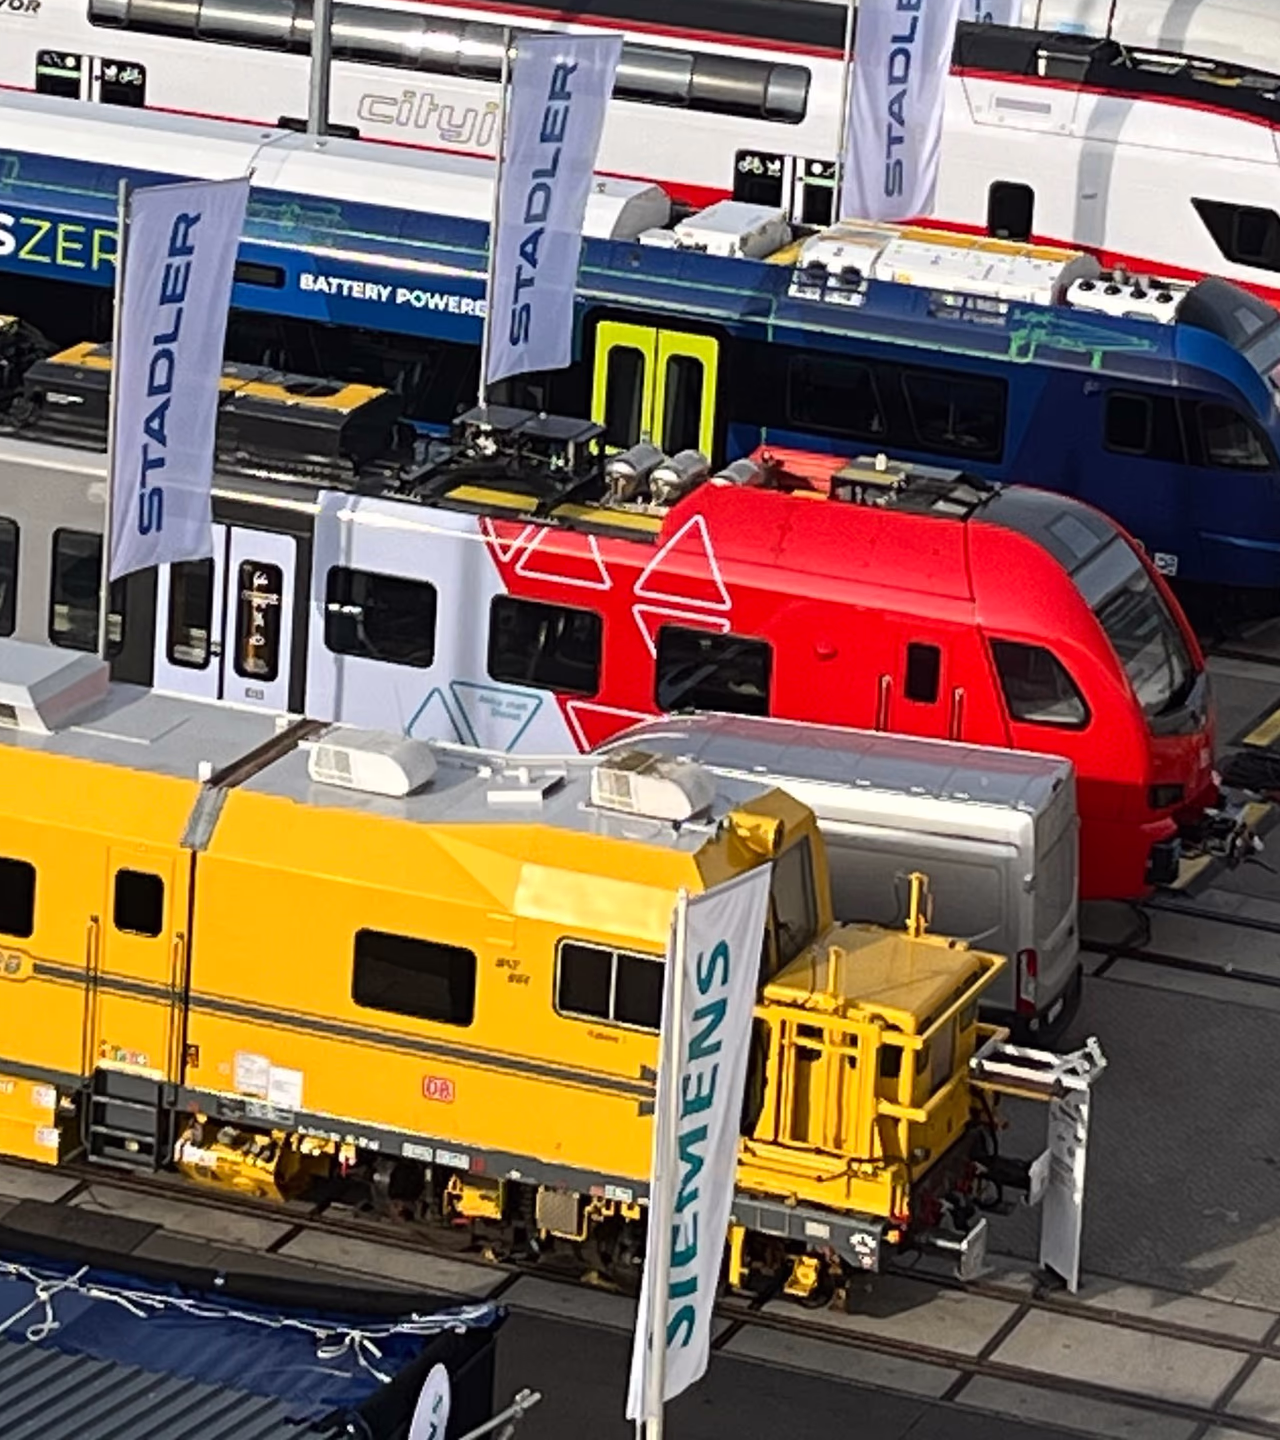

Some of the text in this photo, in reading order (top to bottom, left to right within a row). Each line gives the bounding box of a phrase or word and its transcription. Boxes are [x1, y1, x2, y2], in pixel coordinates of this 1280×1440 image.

[298, 272, 394, 305] BATTERY
[509, 60, 579, 347] STADLER
[138, 210, 203, 537] STADLER
[666, 938, 731, 1351] SIEMENS
